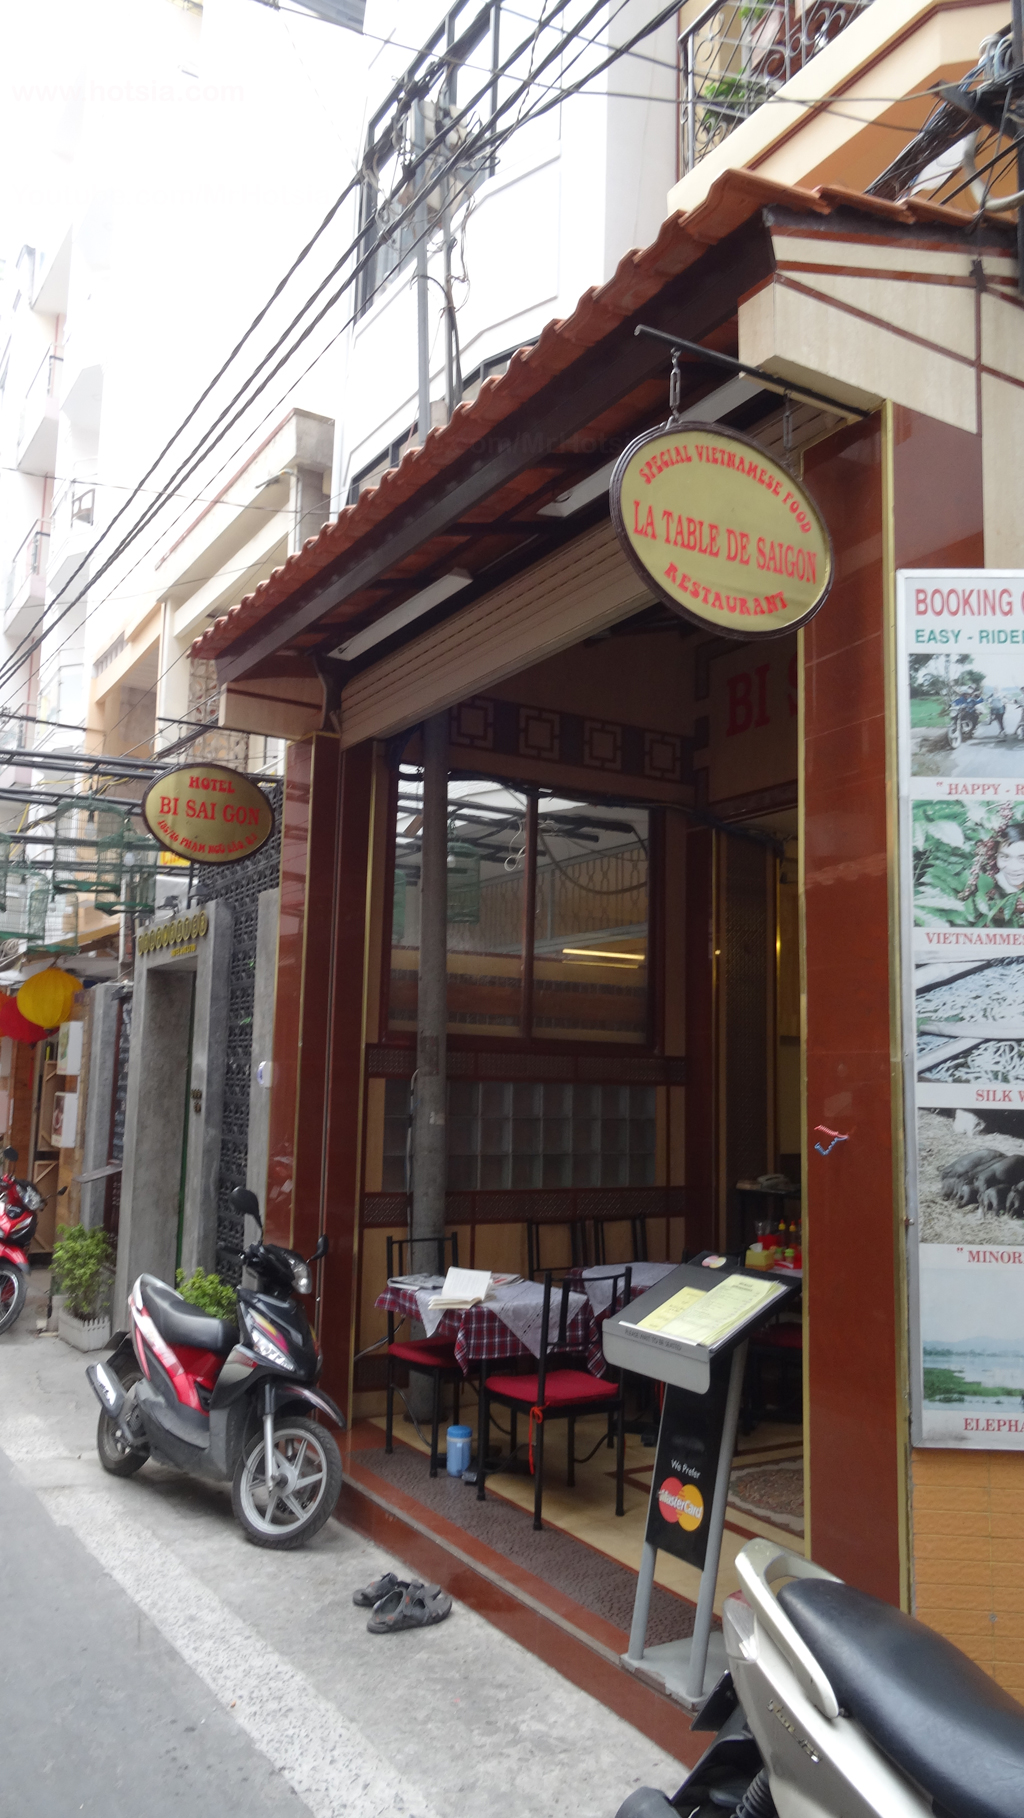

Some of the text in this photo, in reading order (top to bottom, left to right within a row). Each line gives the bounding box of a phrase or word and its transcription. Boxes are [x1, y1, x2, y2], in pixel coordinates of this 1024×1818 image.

[639, 445, 811, 533] SPECIAL VIETNAMESE FOOD
[633, 500, 818, 585] LA TABLE DE SAIGON
[664, 563, 787, 615] RESTAURANT
[914, 588, 1014, 617] BOOKING
[914, 629, 963, 645] EASY
[726, 662, 771, 738] BI
[189, 776, 235, 793] HOTEL
[160, 796, 259, 825] BI SAI GON
[975, 1089, 1013, 1103] SILK
[671, 1458, 701, 1479] We Prefer
[658, 1489, 703, 1519] MasterCard
